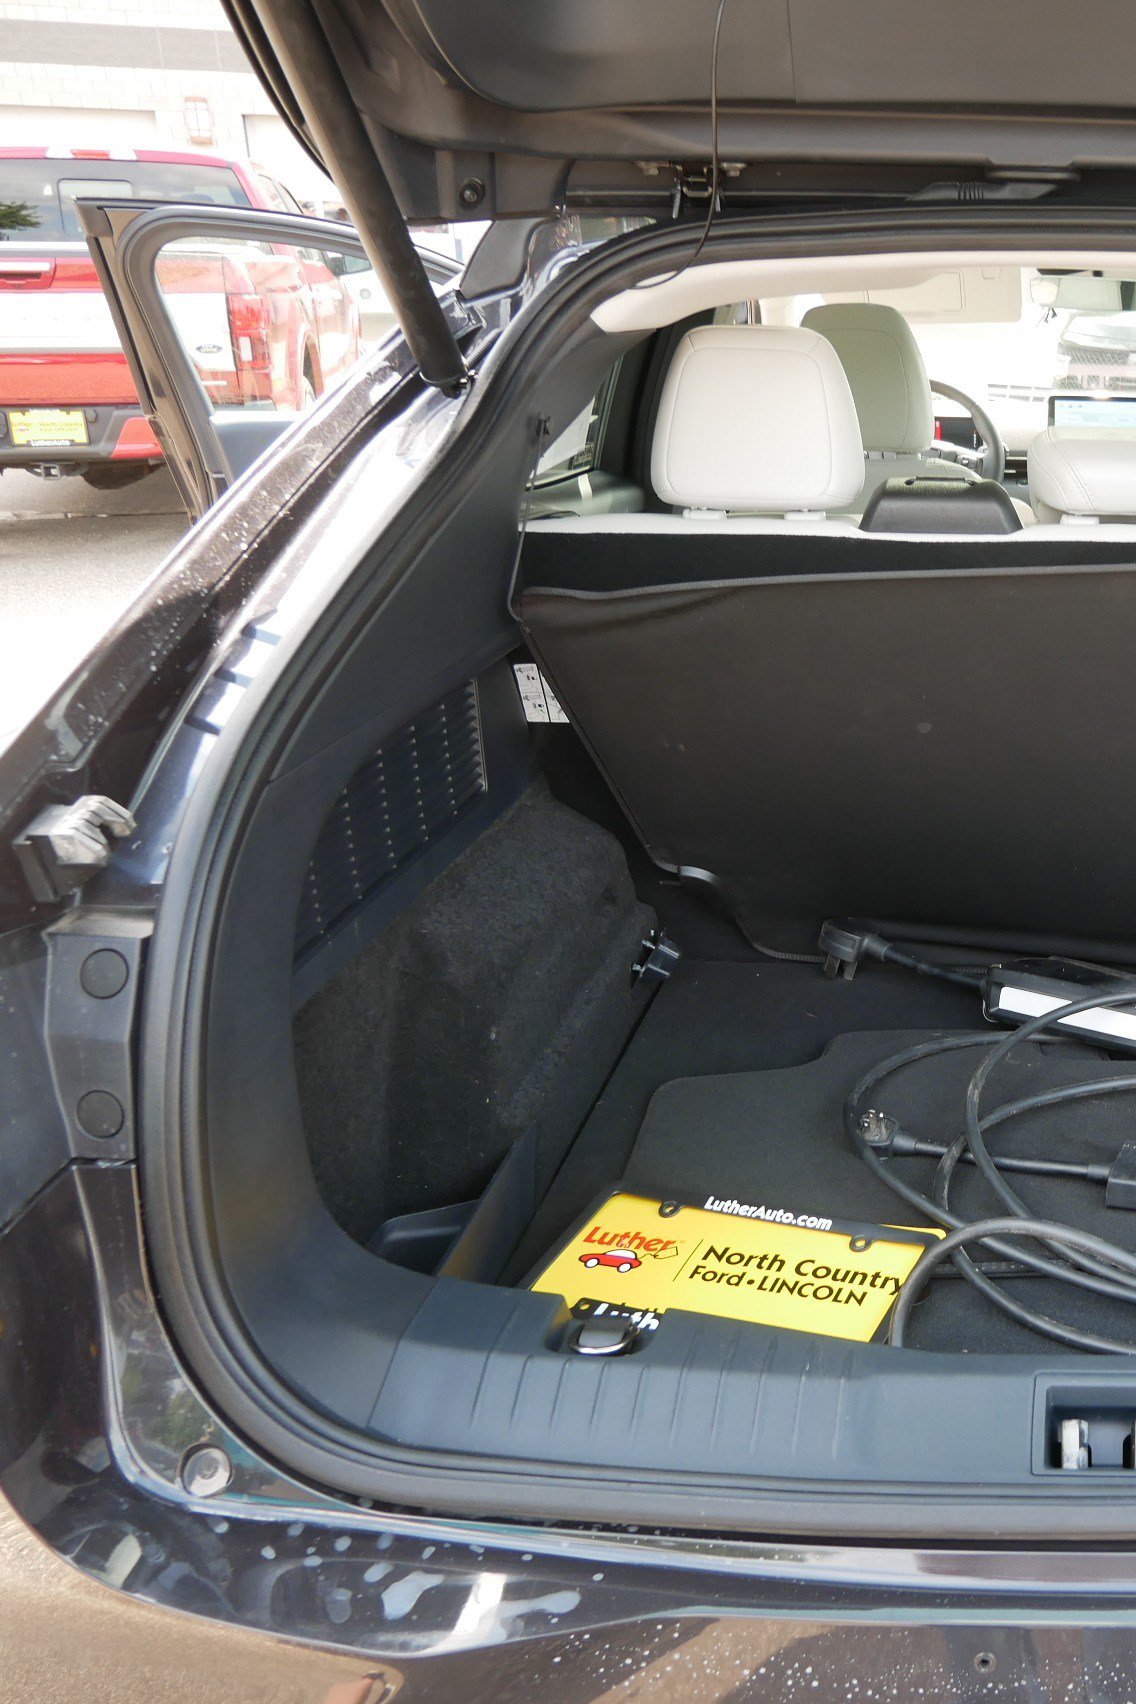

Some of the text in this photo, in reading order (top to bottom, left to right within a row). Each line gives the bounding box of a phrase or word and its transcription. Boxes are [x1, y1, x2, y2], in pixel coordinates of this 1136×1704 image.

[704, 1195, 833, 1231] LutherAuto.com
[583, 1226, 677, 1252] Luther
[701, 1245, 904, 1296] North Country
